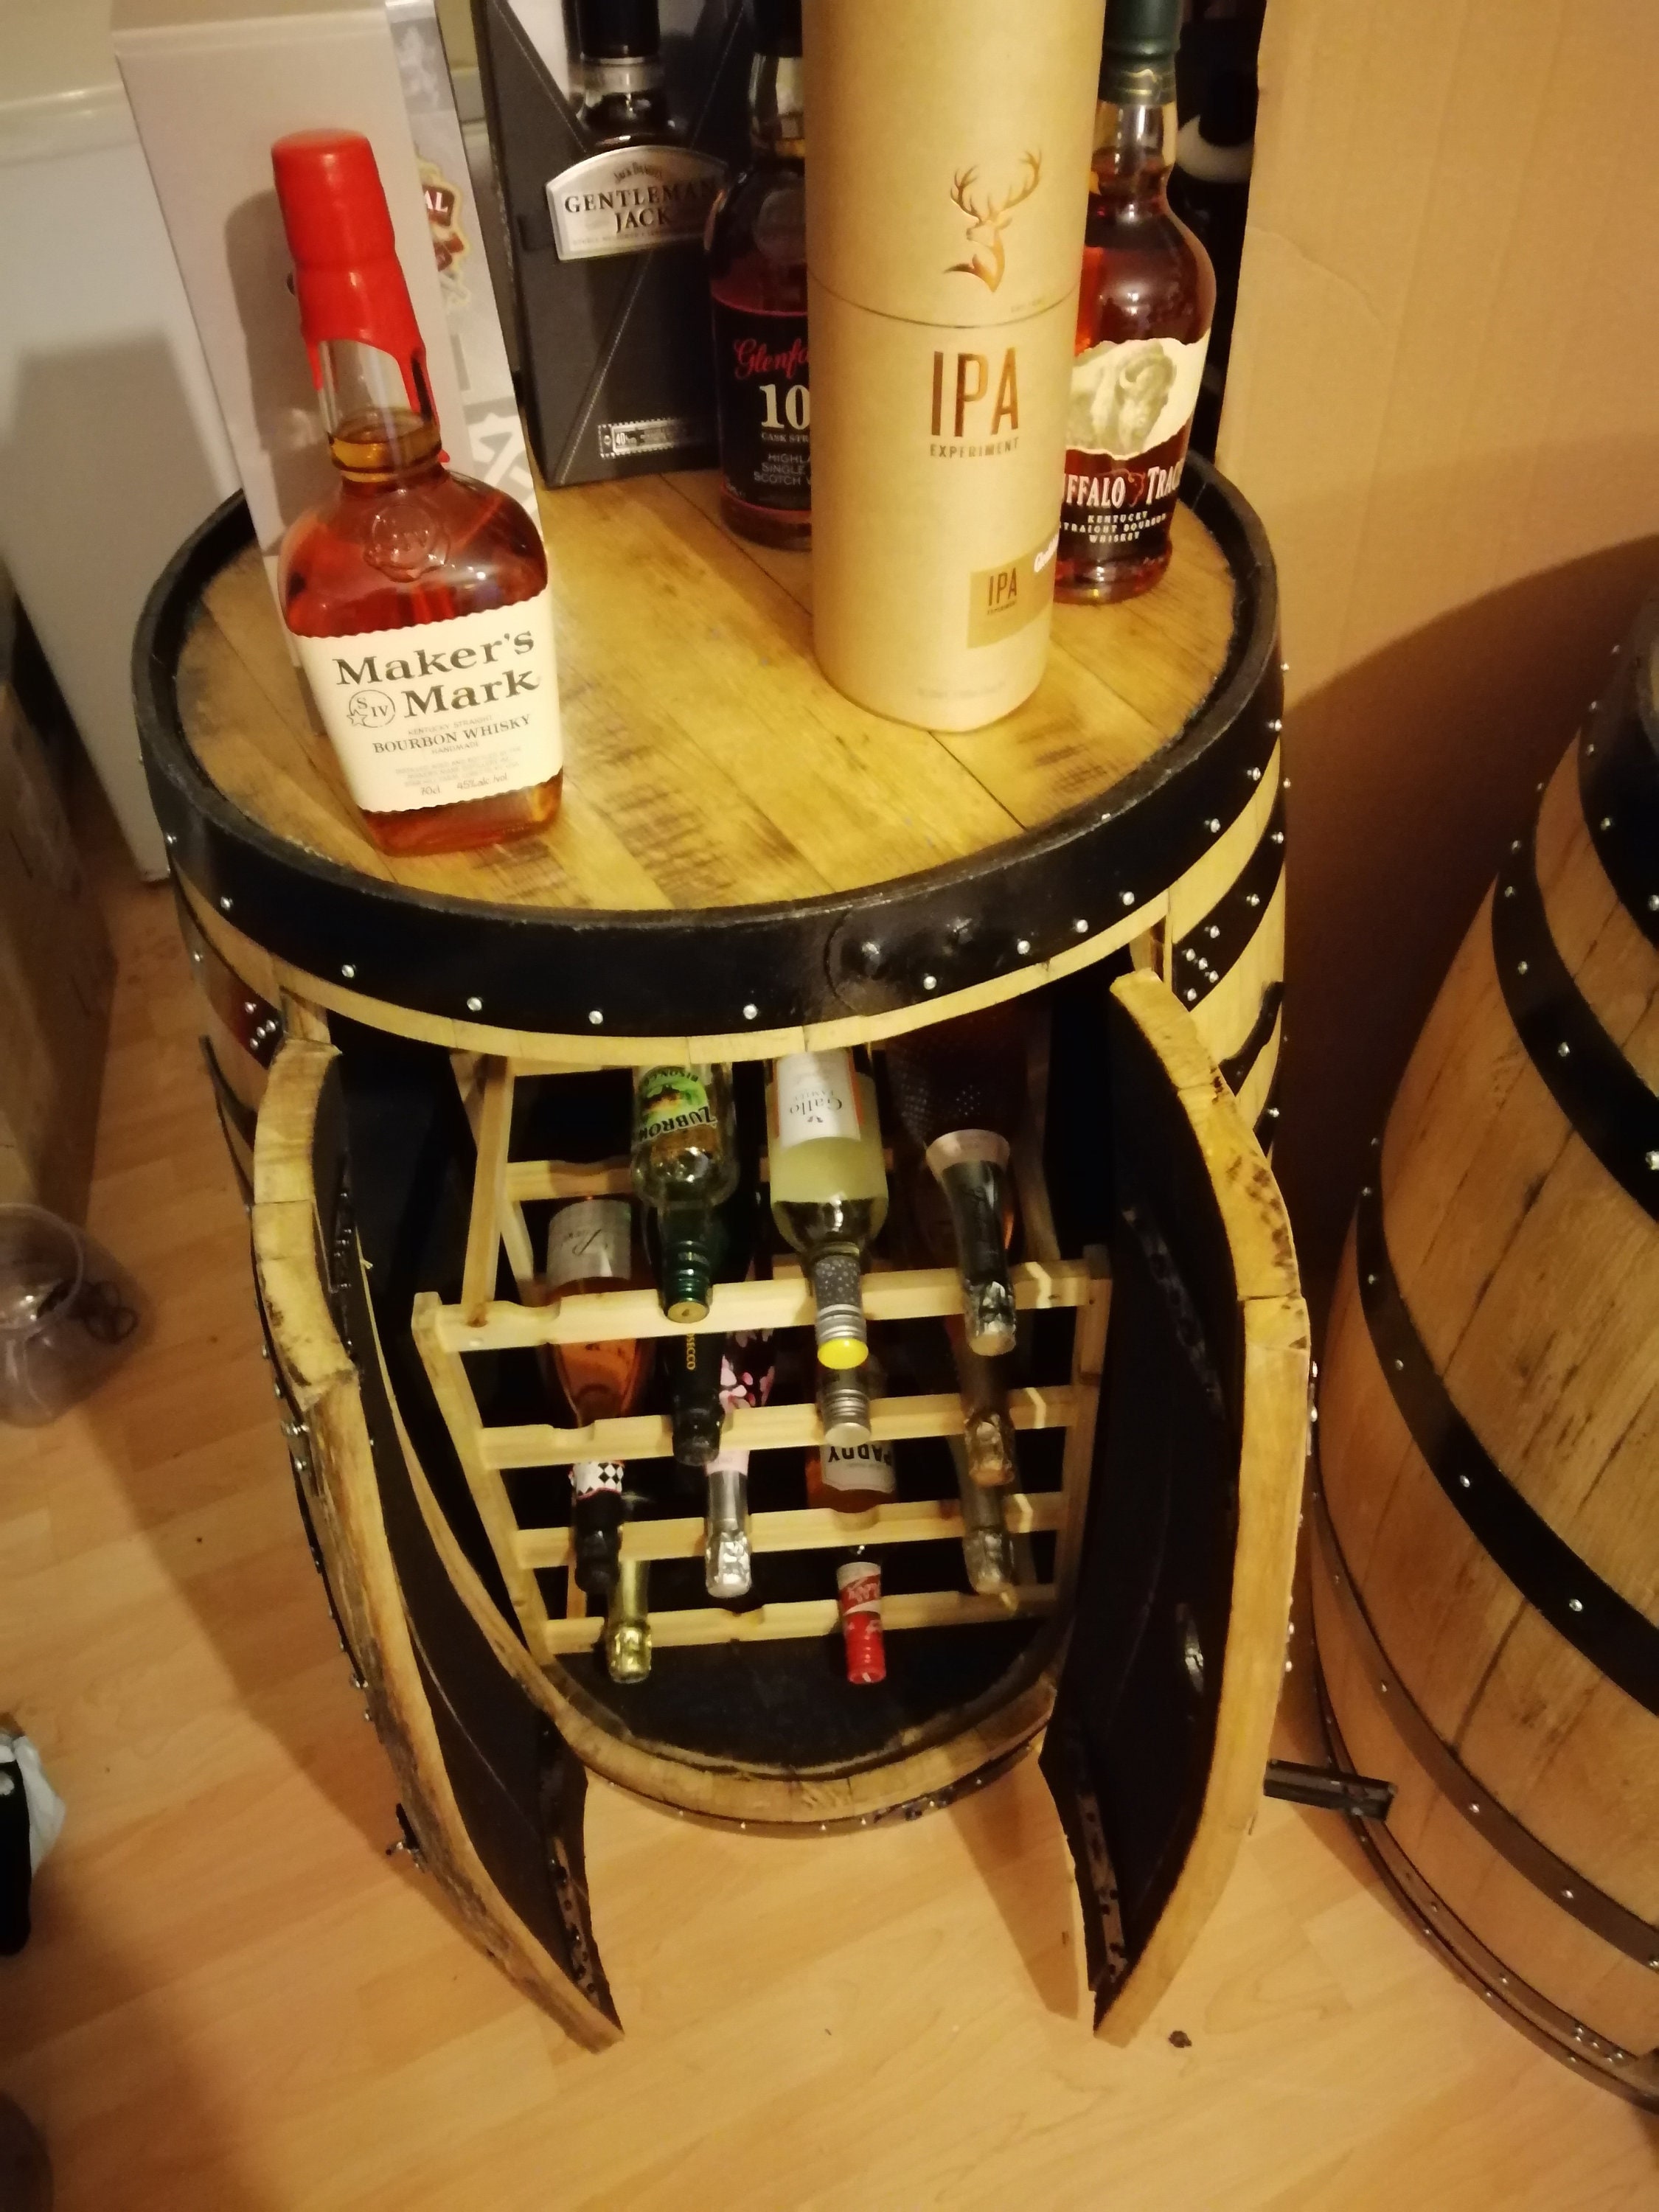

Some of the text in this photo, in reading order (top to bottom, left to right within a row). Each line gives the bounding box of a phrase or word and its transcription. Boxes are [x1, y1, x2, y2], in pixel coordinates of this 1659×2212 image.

[615, 207, 672, 233] JACK
[734, 338, 810, 380] Glenfa
[931, 347, 1018, 437] IPA
[789, 433, 810, 443] STR
[930, 437, 1019, 458] EXPERIMENT
[754, 471, 801, 486] SCOTCH
[762, 462, 807, 476] SINGLE
[1065, 457, 1185, 509] FFALO TRAC
[1060, 512, 1166, 533] TRAIGHT BOURBON
[1088, 510, 1148, 524] KENTUCKY
[1088, 531, 1140, 543] WHISKEY
[988, 567, 1018, 606] IPA
[332, 630, 535, 685] Maker's
[401, 669, 540, 718] Mark
[372, 714, 531, 754] BOURBON WHISKY
[408, 715, 493, 736] KENTUCKY STRAIGHT
[790, 1098, 842, 1116] Gallo
